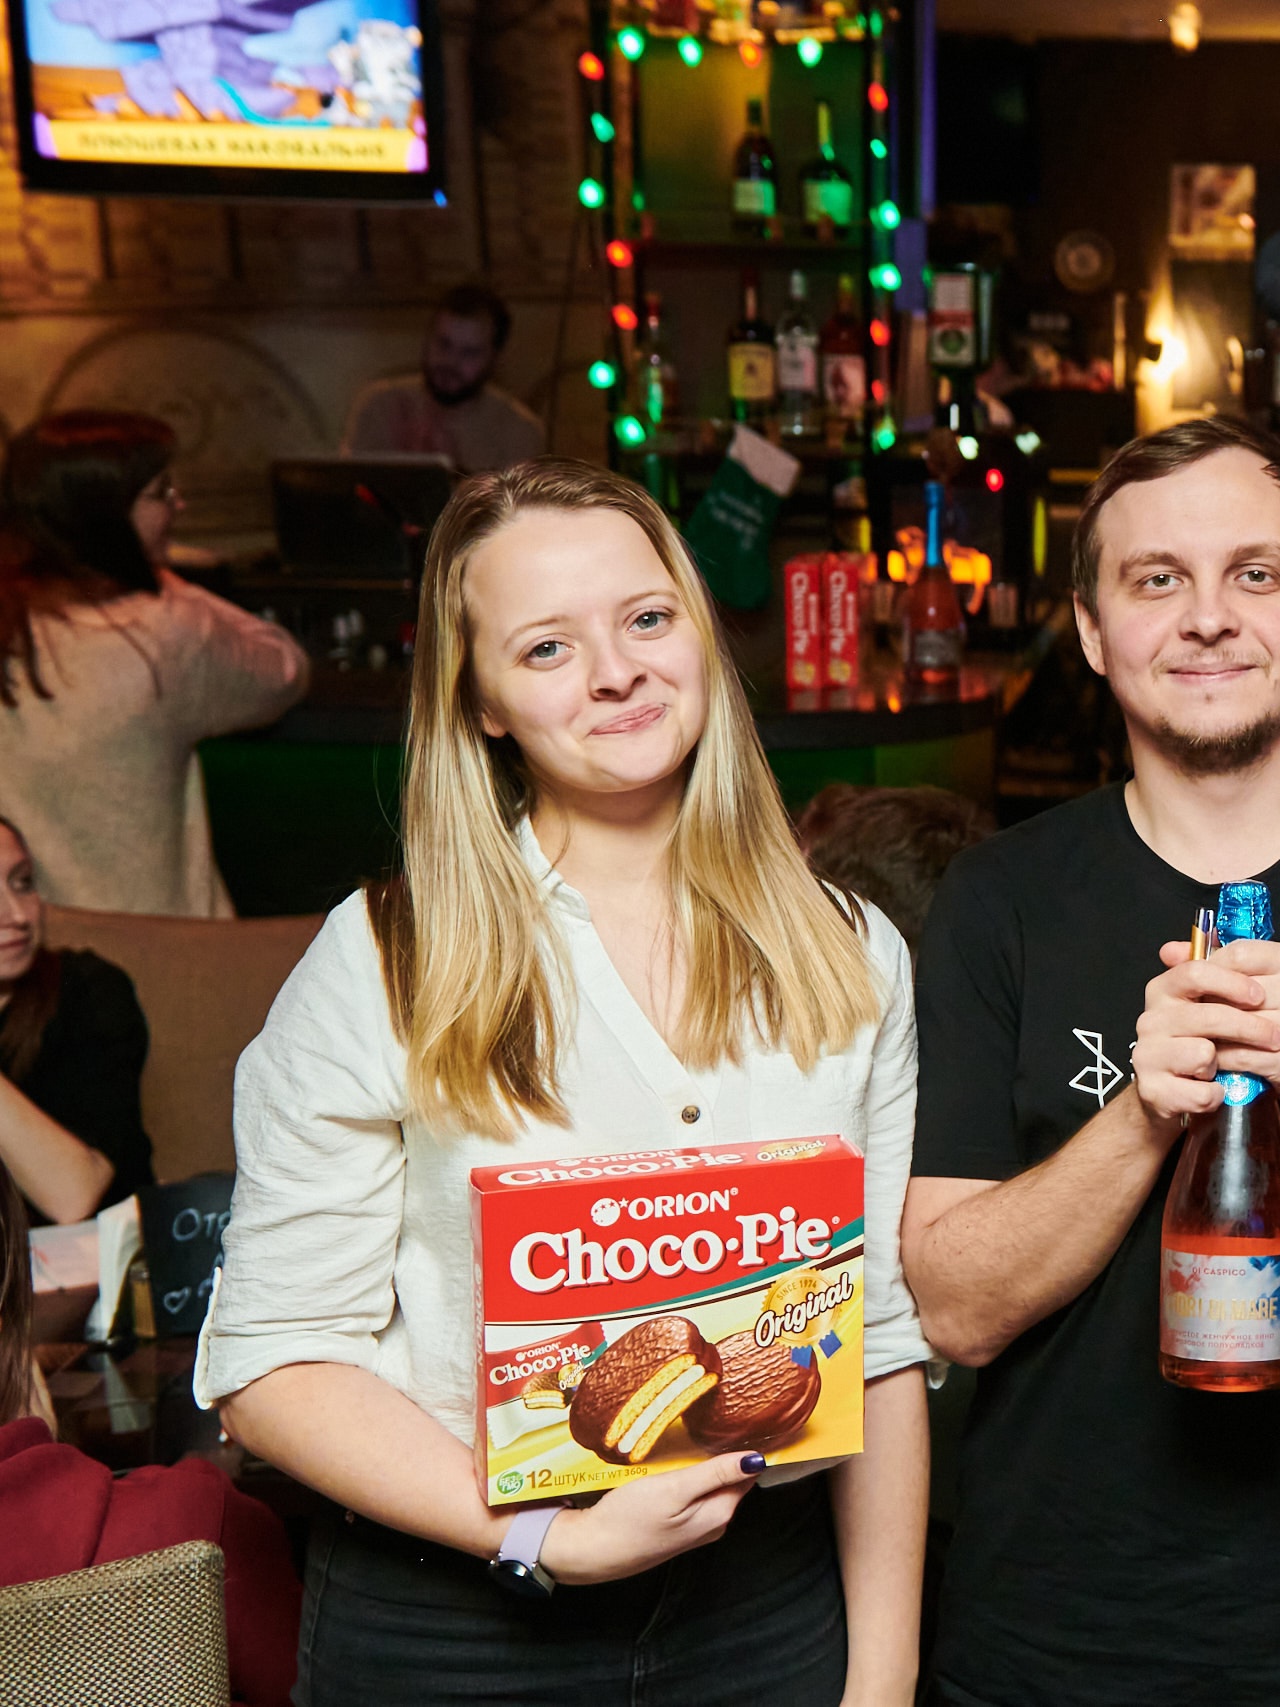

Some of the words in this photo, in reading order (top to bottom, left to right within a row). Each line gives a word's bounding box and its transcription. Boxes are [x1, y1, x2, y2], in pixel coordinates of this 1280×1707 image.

[756, 1139, 827, 1163] Original
[1204, 1267, 1247, 1277] CASPICO
[776, 1281, 798, 1301] SINCE
[754, 1271, 854, 1348] Original
[526, 1468, 553, 1489] 12
[588, 1471, 606, 1481] NET
[607, 1470, 623, 1479] WT
[625, 1466, 648, 1477] 360g
